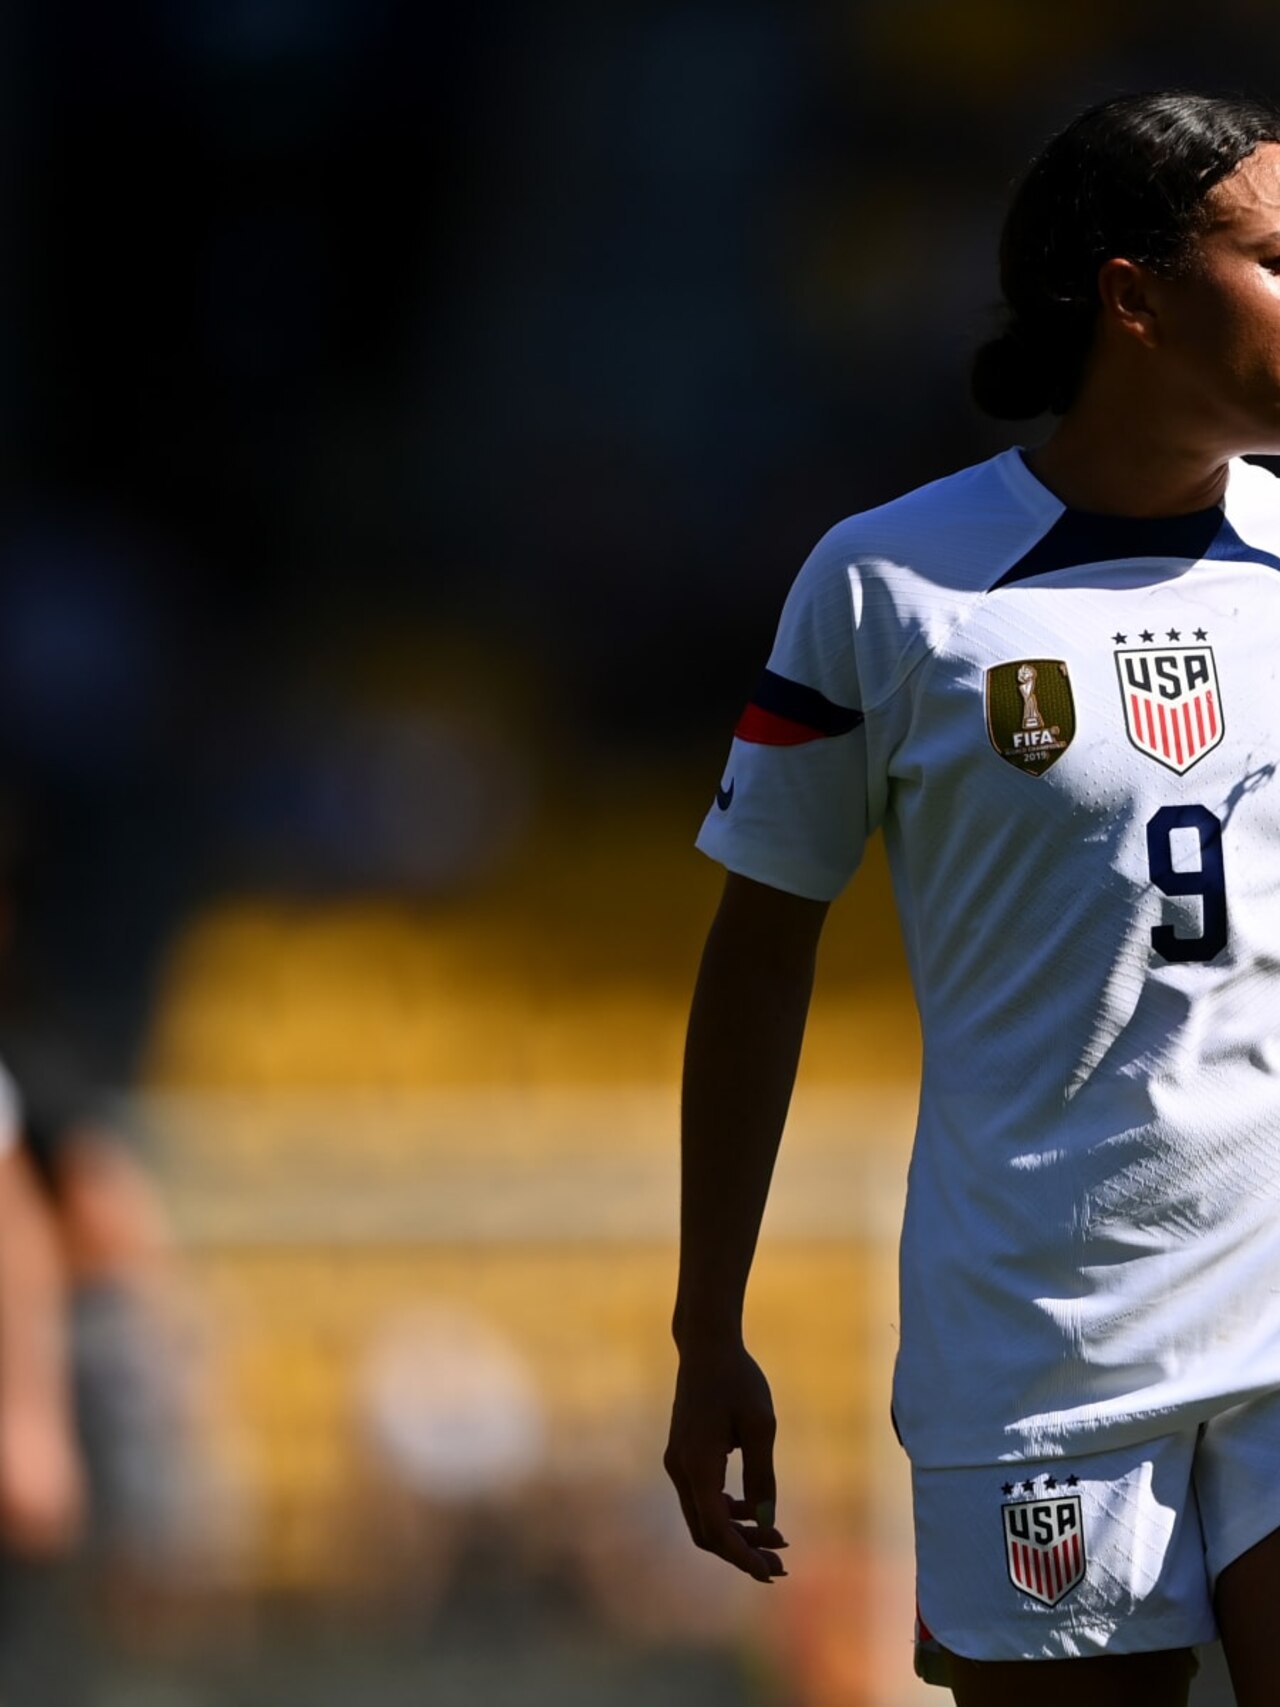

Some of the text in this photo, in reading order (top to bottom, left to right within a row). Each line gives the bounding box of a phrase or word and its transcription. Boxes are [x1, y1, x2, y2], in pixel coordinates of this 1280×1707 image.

[1125, 655, 1209, 700] USA
[1013, 730, 1053, 748] FIFA
[1146, 804, 1228, 962] 9
[1008, 1503, 1076, 1545] USA
